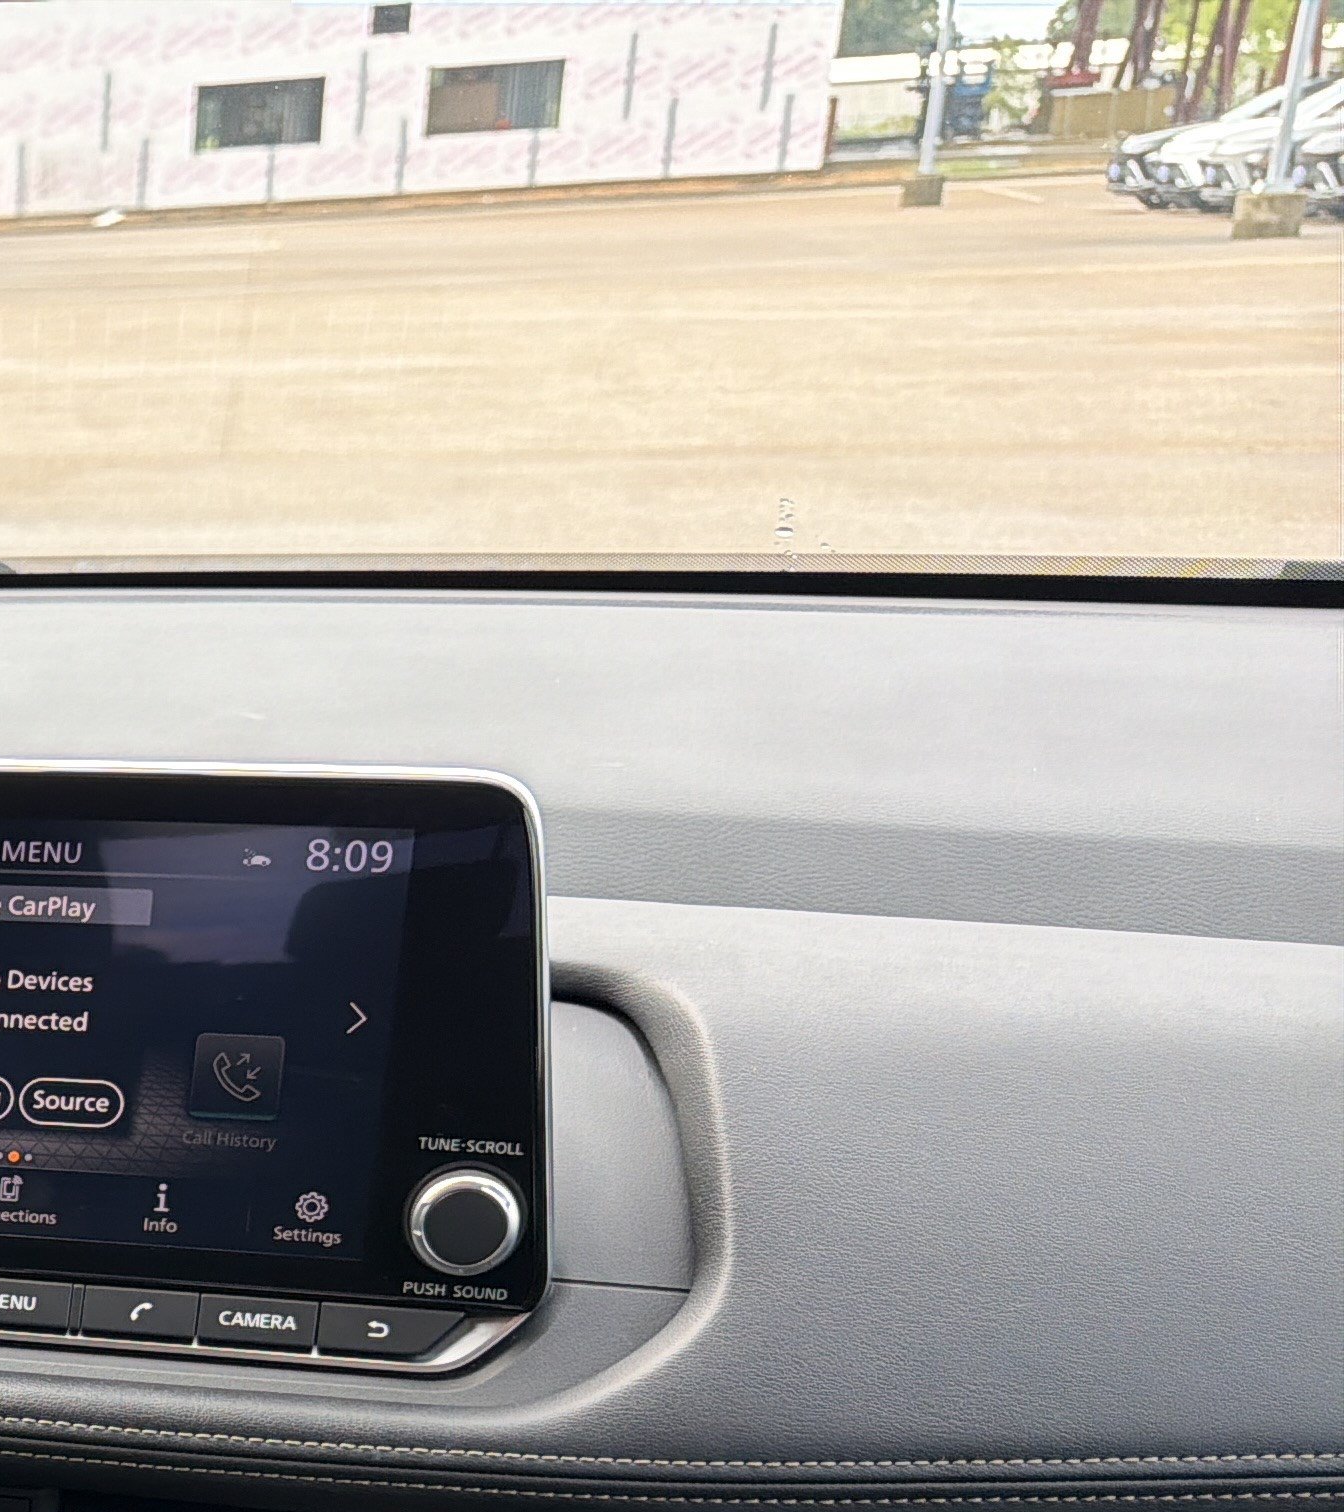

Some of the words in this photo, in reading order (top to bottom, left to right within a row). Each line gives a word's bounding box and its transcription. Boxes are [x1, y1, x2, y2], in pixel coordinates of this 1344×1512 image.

[1, 840, 82, 864] MENU
[306, 838, 394, 873] 8:09
[8, 896, 97, 922] CarPlay
[7, 970, 94, 993] Devices
[32, 1090, 110, 1114] Source
[181, 1129, 213, 1148] Call
[216, 1131, 278, 1153] History
[143, 1217, 178, 1236] Info
[272, 1225, 342, 1248] Settings
[402, 1280, 446, 1298] PUSH
[452, 1282, 509, 1301] SOUND
[218, 1309, 298, 1332] CAMERA
